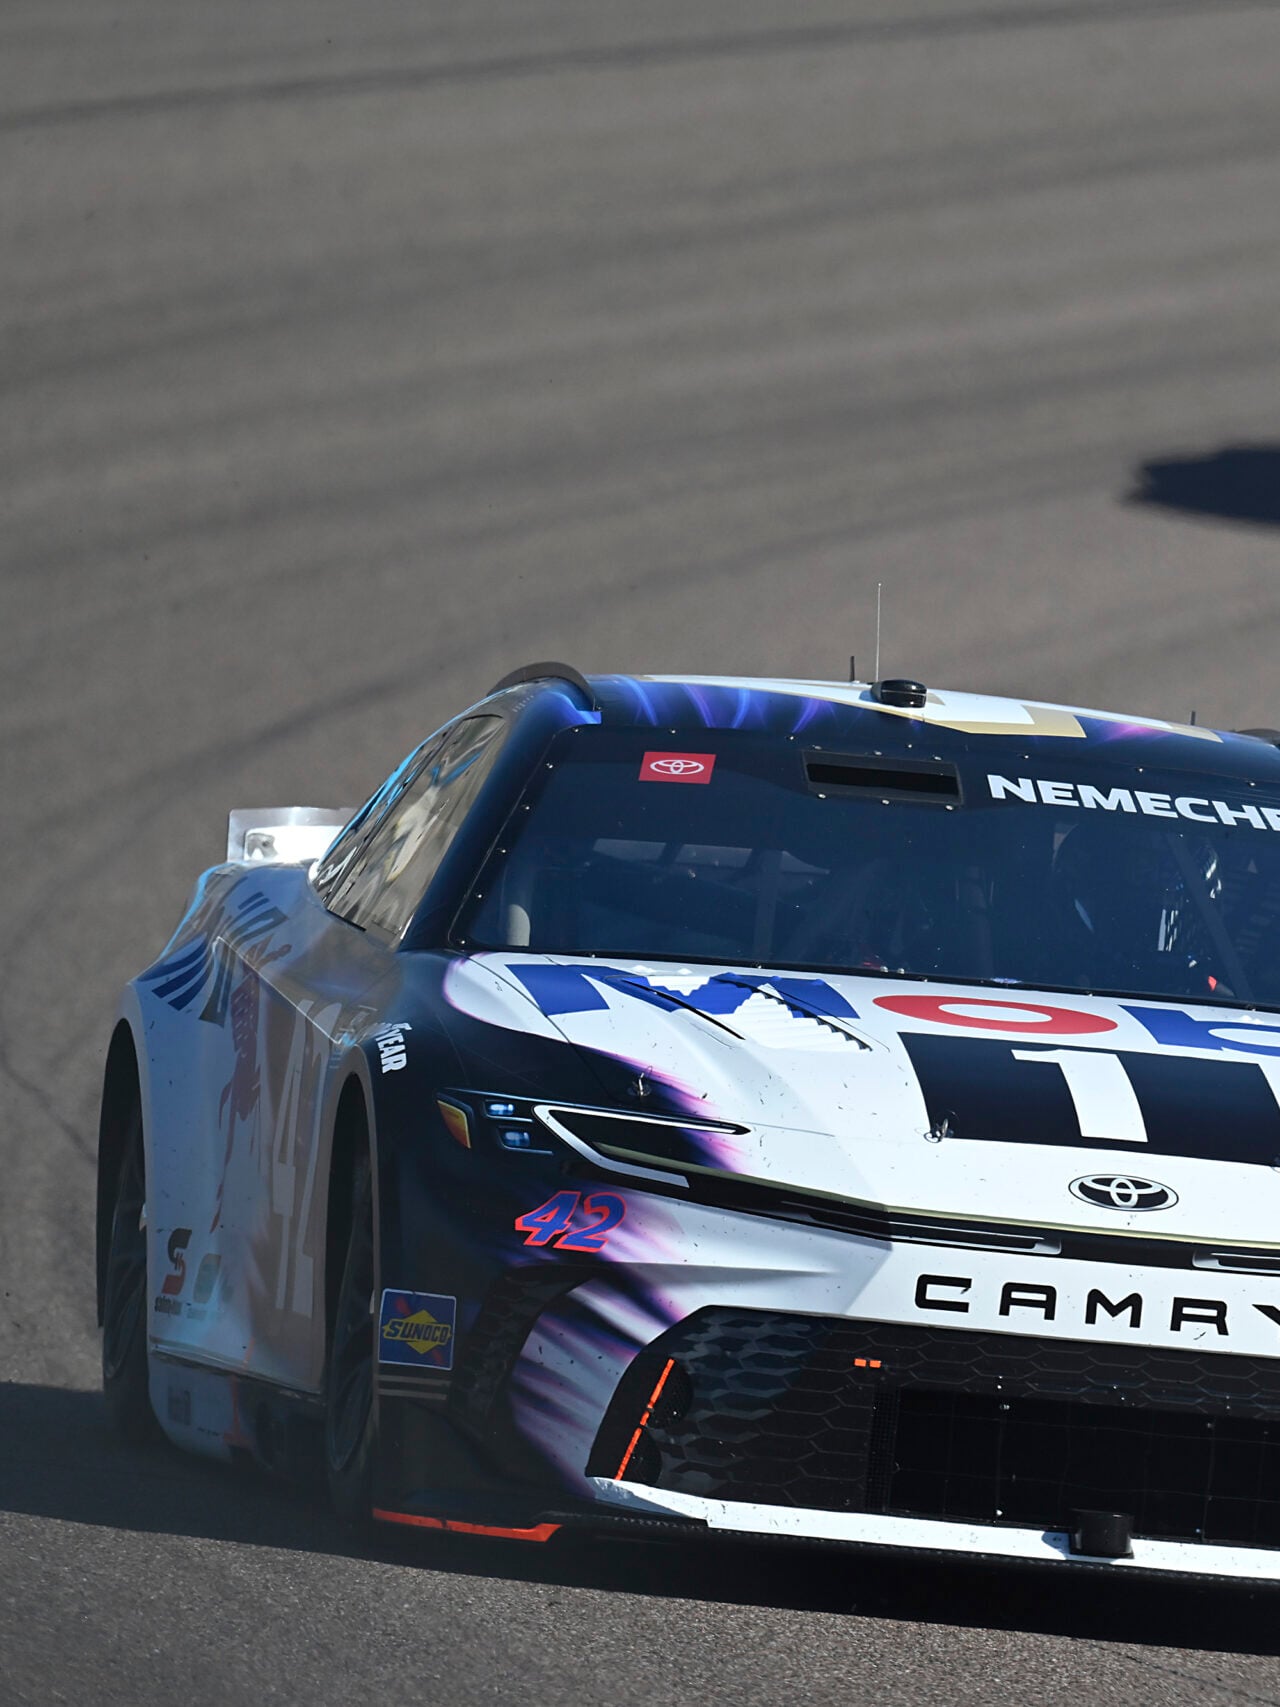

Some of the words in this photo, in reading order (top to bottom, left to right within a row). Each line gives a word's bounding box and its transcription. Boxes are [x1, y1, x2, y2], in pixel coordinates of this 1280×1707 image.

[1011, 1048, 1149, 1143] 1
[515, 1190, 627, 1253] 42
[384, 1320, 450, 1344] SUNOCO
